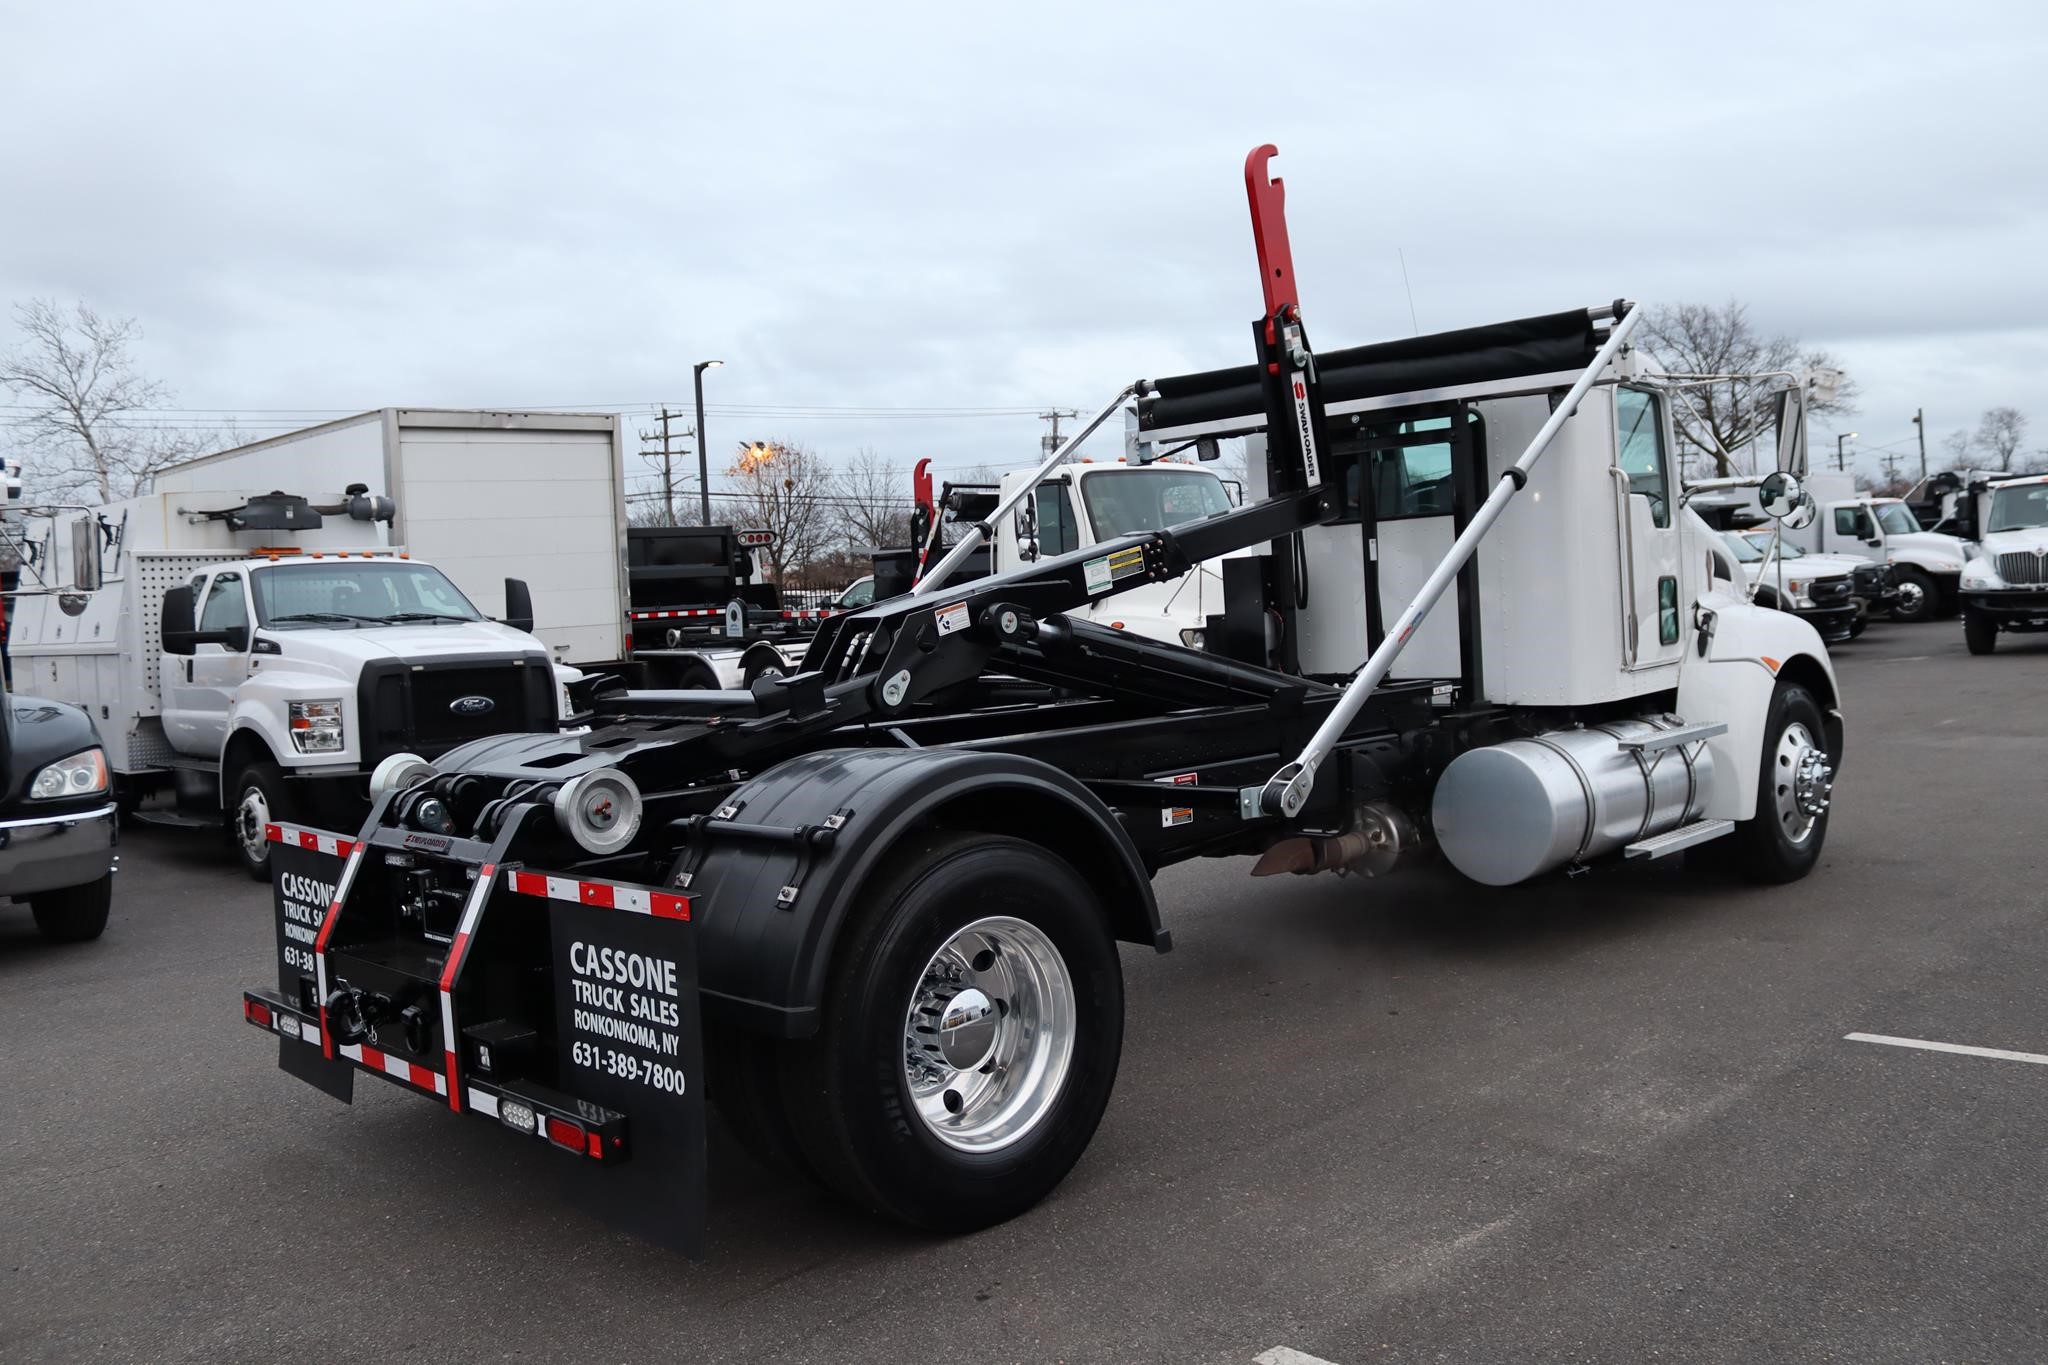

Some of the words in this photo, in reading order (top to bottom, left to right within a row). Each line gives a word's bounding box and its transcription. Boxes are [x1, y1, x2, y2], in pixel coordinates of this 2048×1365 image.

[1298, 402, 1315, 477] SWAPLOADER
[283, 900, 311, 924] TRUCK
[570, 941, 678, 996] CASSONE
[572, 979, 625, 1013] TRUCK
[630, 993, 680, 1027] SALES
[574, 1009, 661, 1054] RONKONKOMA,
[662, 1032, 679, 1056] NY
[572, 1041, 685, 1095] 631-389-7800
